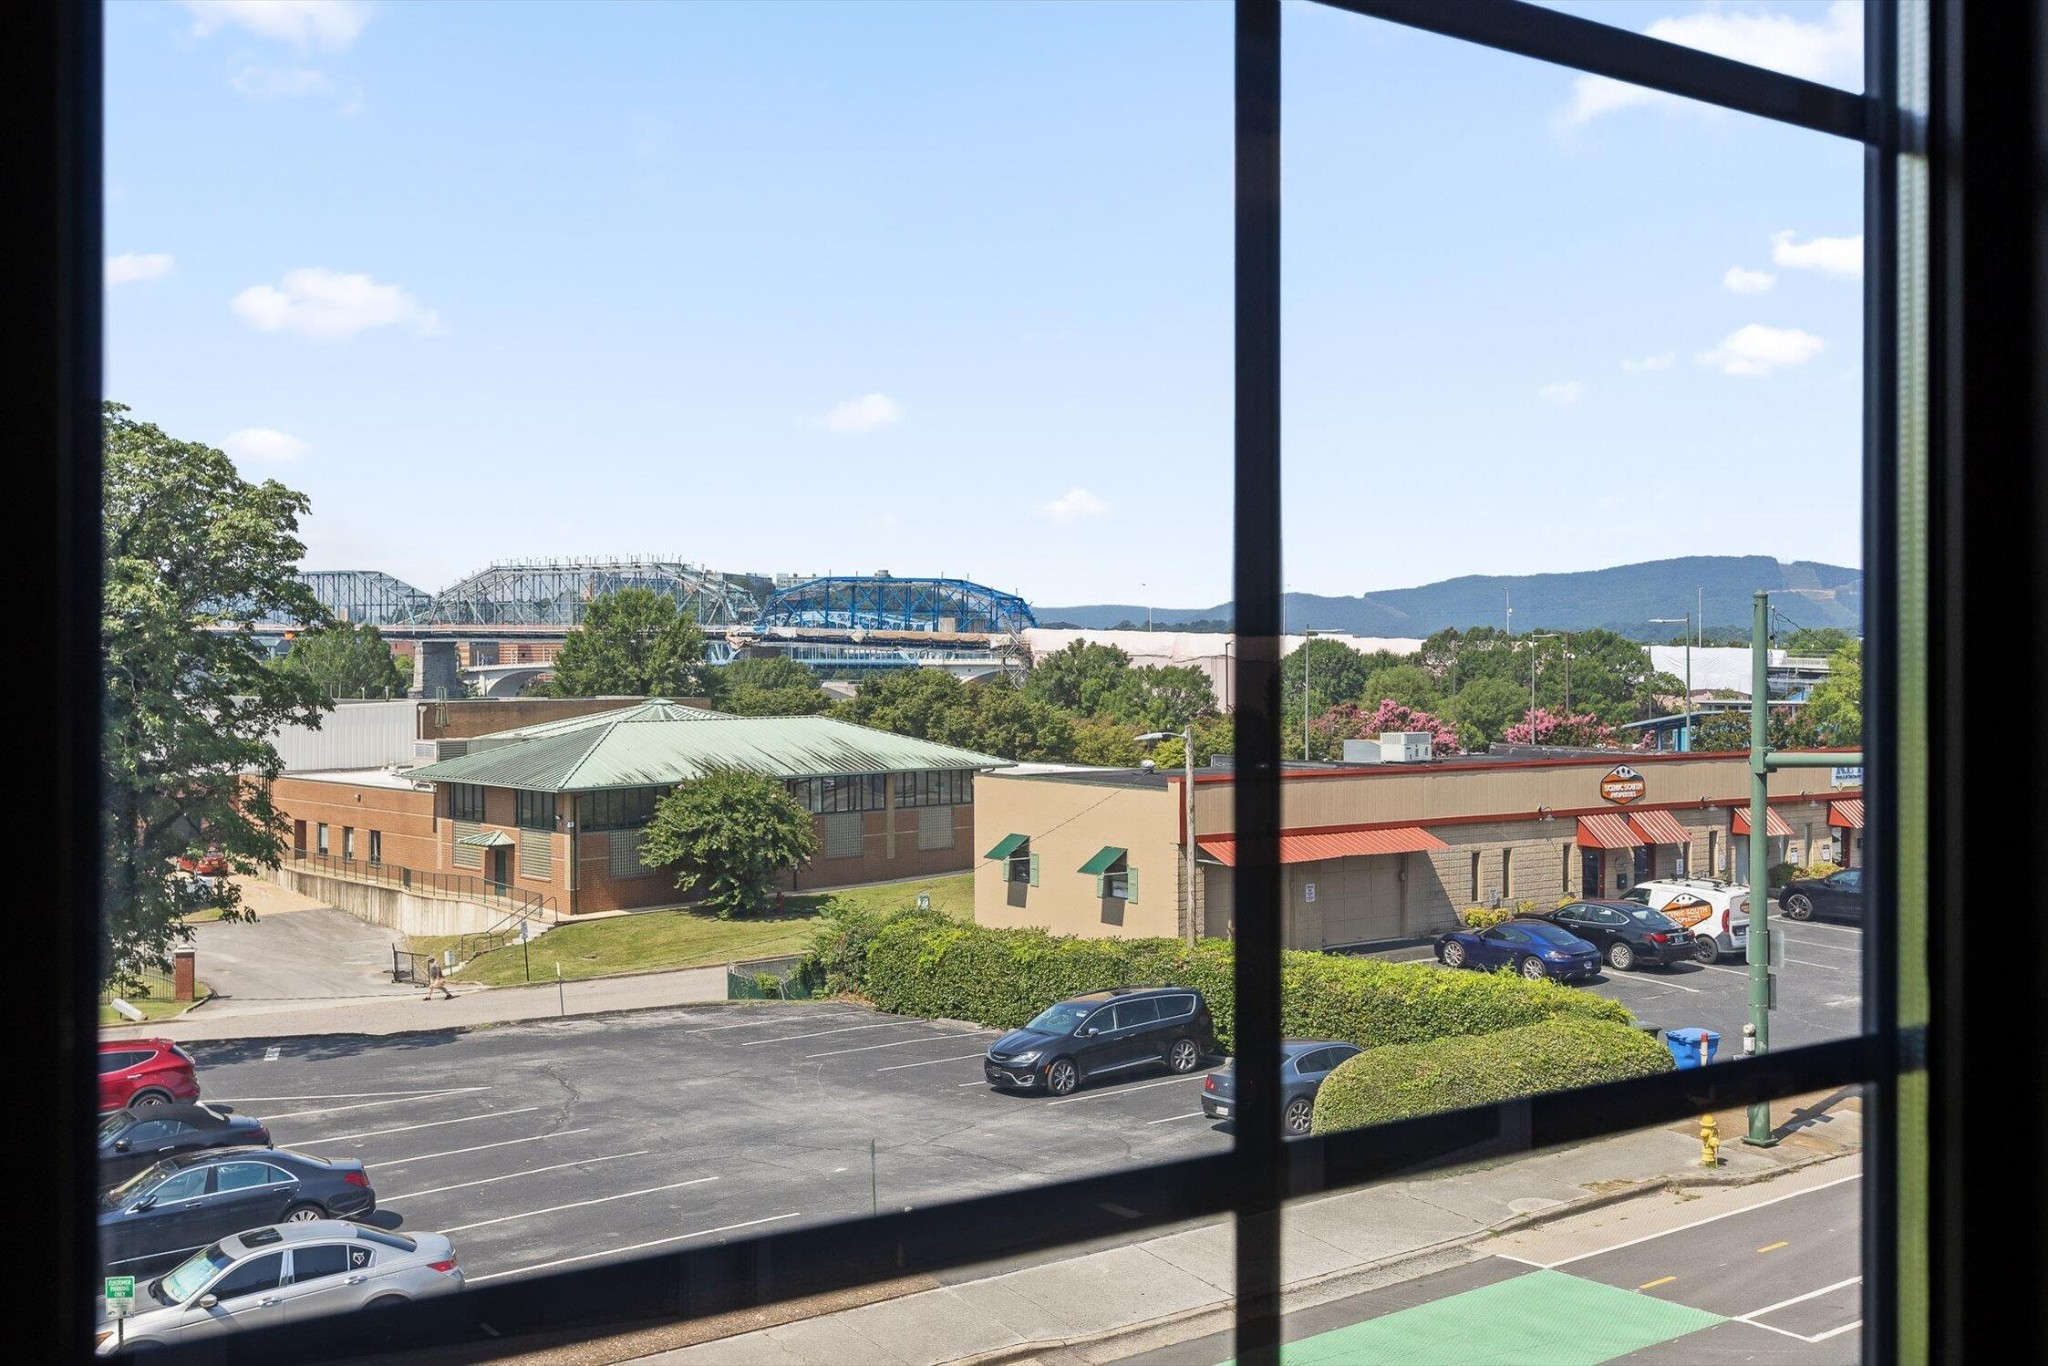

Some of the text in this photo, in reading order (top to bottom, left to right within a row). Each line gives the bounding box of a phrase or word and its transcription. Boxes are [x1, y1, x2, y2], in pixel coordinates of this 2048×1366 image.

[1604, 783, 1643, 791] SCENIC SOUTH
[1687, 905, 1708, 914] SOUTH
